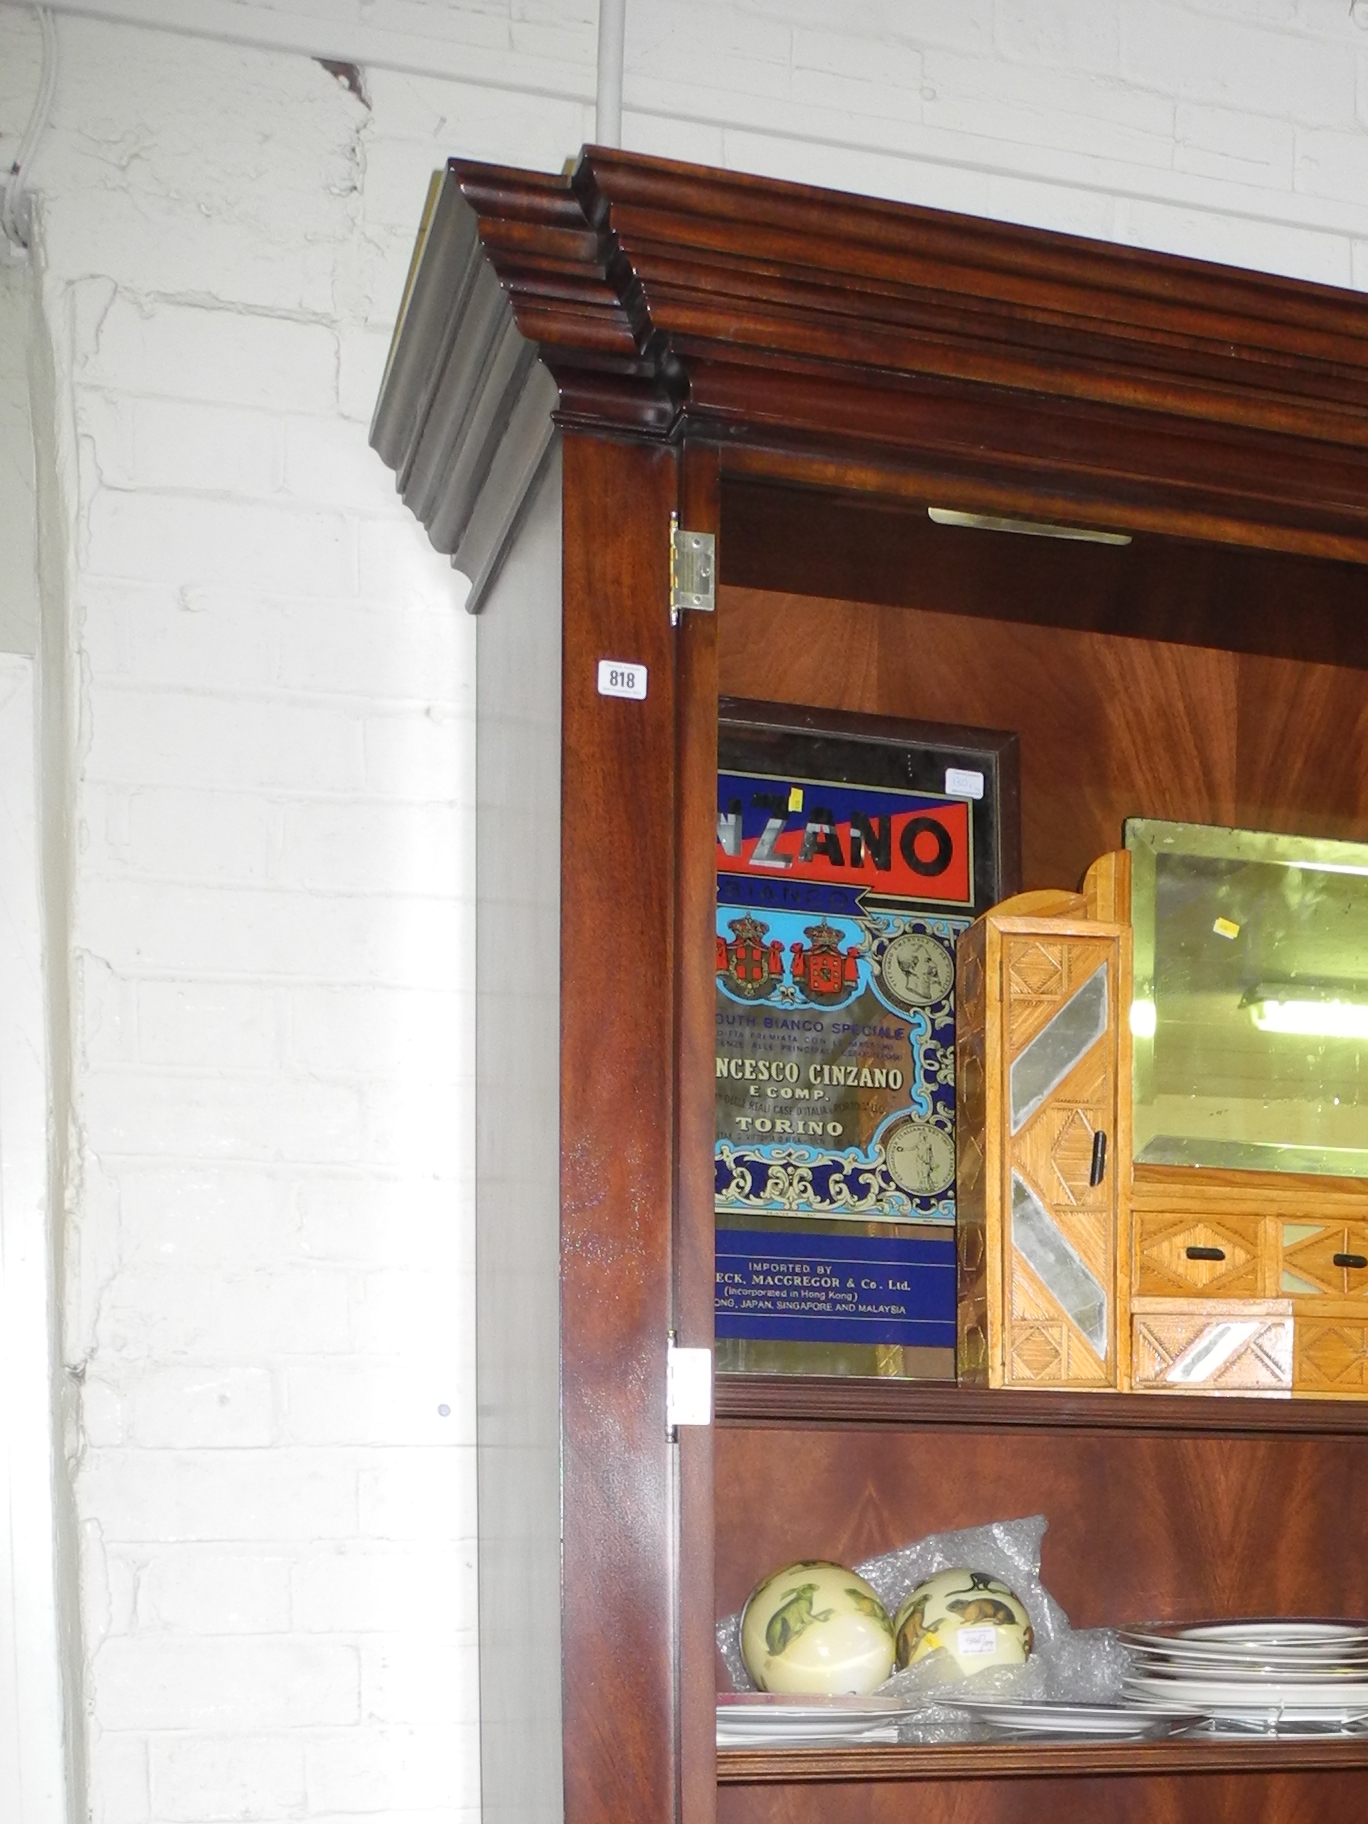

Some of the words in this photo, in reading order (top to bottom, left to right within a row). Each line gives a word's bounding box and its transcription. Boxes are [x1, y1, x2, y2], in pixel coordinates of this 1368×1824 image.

[609, 670, 635, 689] 818
[725, 880, 849, 908] BIANCO
[763, 1017, 824, 1033] BIANCO
[832, 1023, 905, 1041] SPECIALE
[808, 1064, 903, 1091] CINZANO
[750, 1085, 760, 1097] E
[766, 1086, 830, 1102] COMP.
[773, 1105, 793, 1116] CASE
[736, 1116, 844, 1137] TORINO
[749, 1262, 811, 1274] IMPORTED
[817, 1265, 833, 1275] BY
[752, 1275, 840, 1288] MACGREGOR
[846, 1278, 855, 1288] &
[888, 1280, 911, 1291] Ltd.
[790, 1289, 799, 1298] in
[801, 1290, 827, 1301] Hong
[828, 1291, 858, 1303] Kong)
[776, 1301, 833, 1313] SINGAPORE
[835, 1303, 856, 1313] AND
[859, 1303, 907, 1315] MALAYSIA
